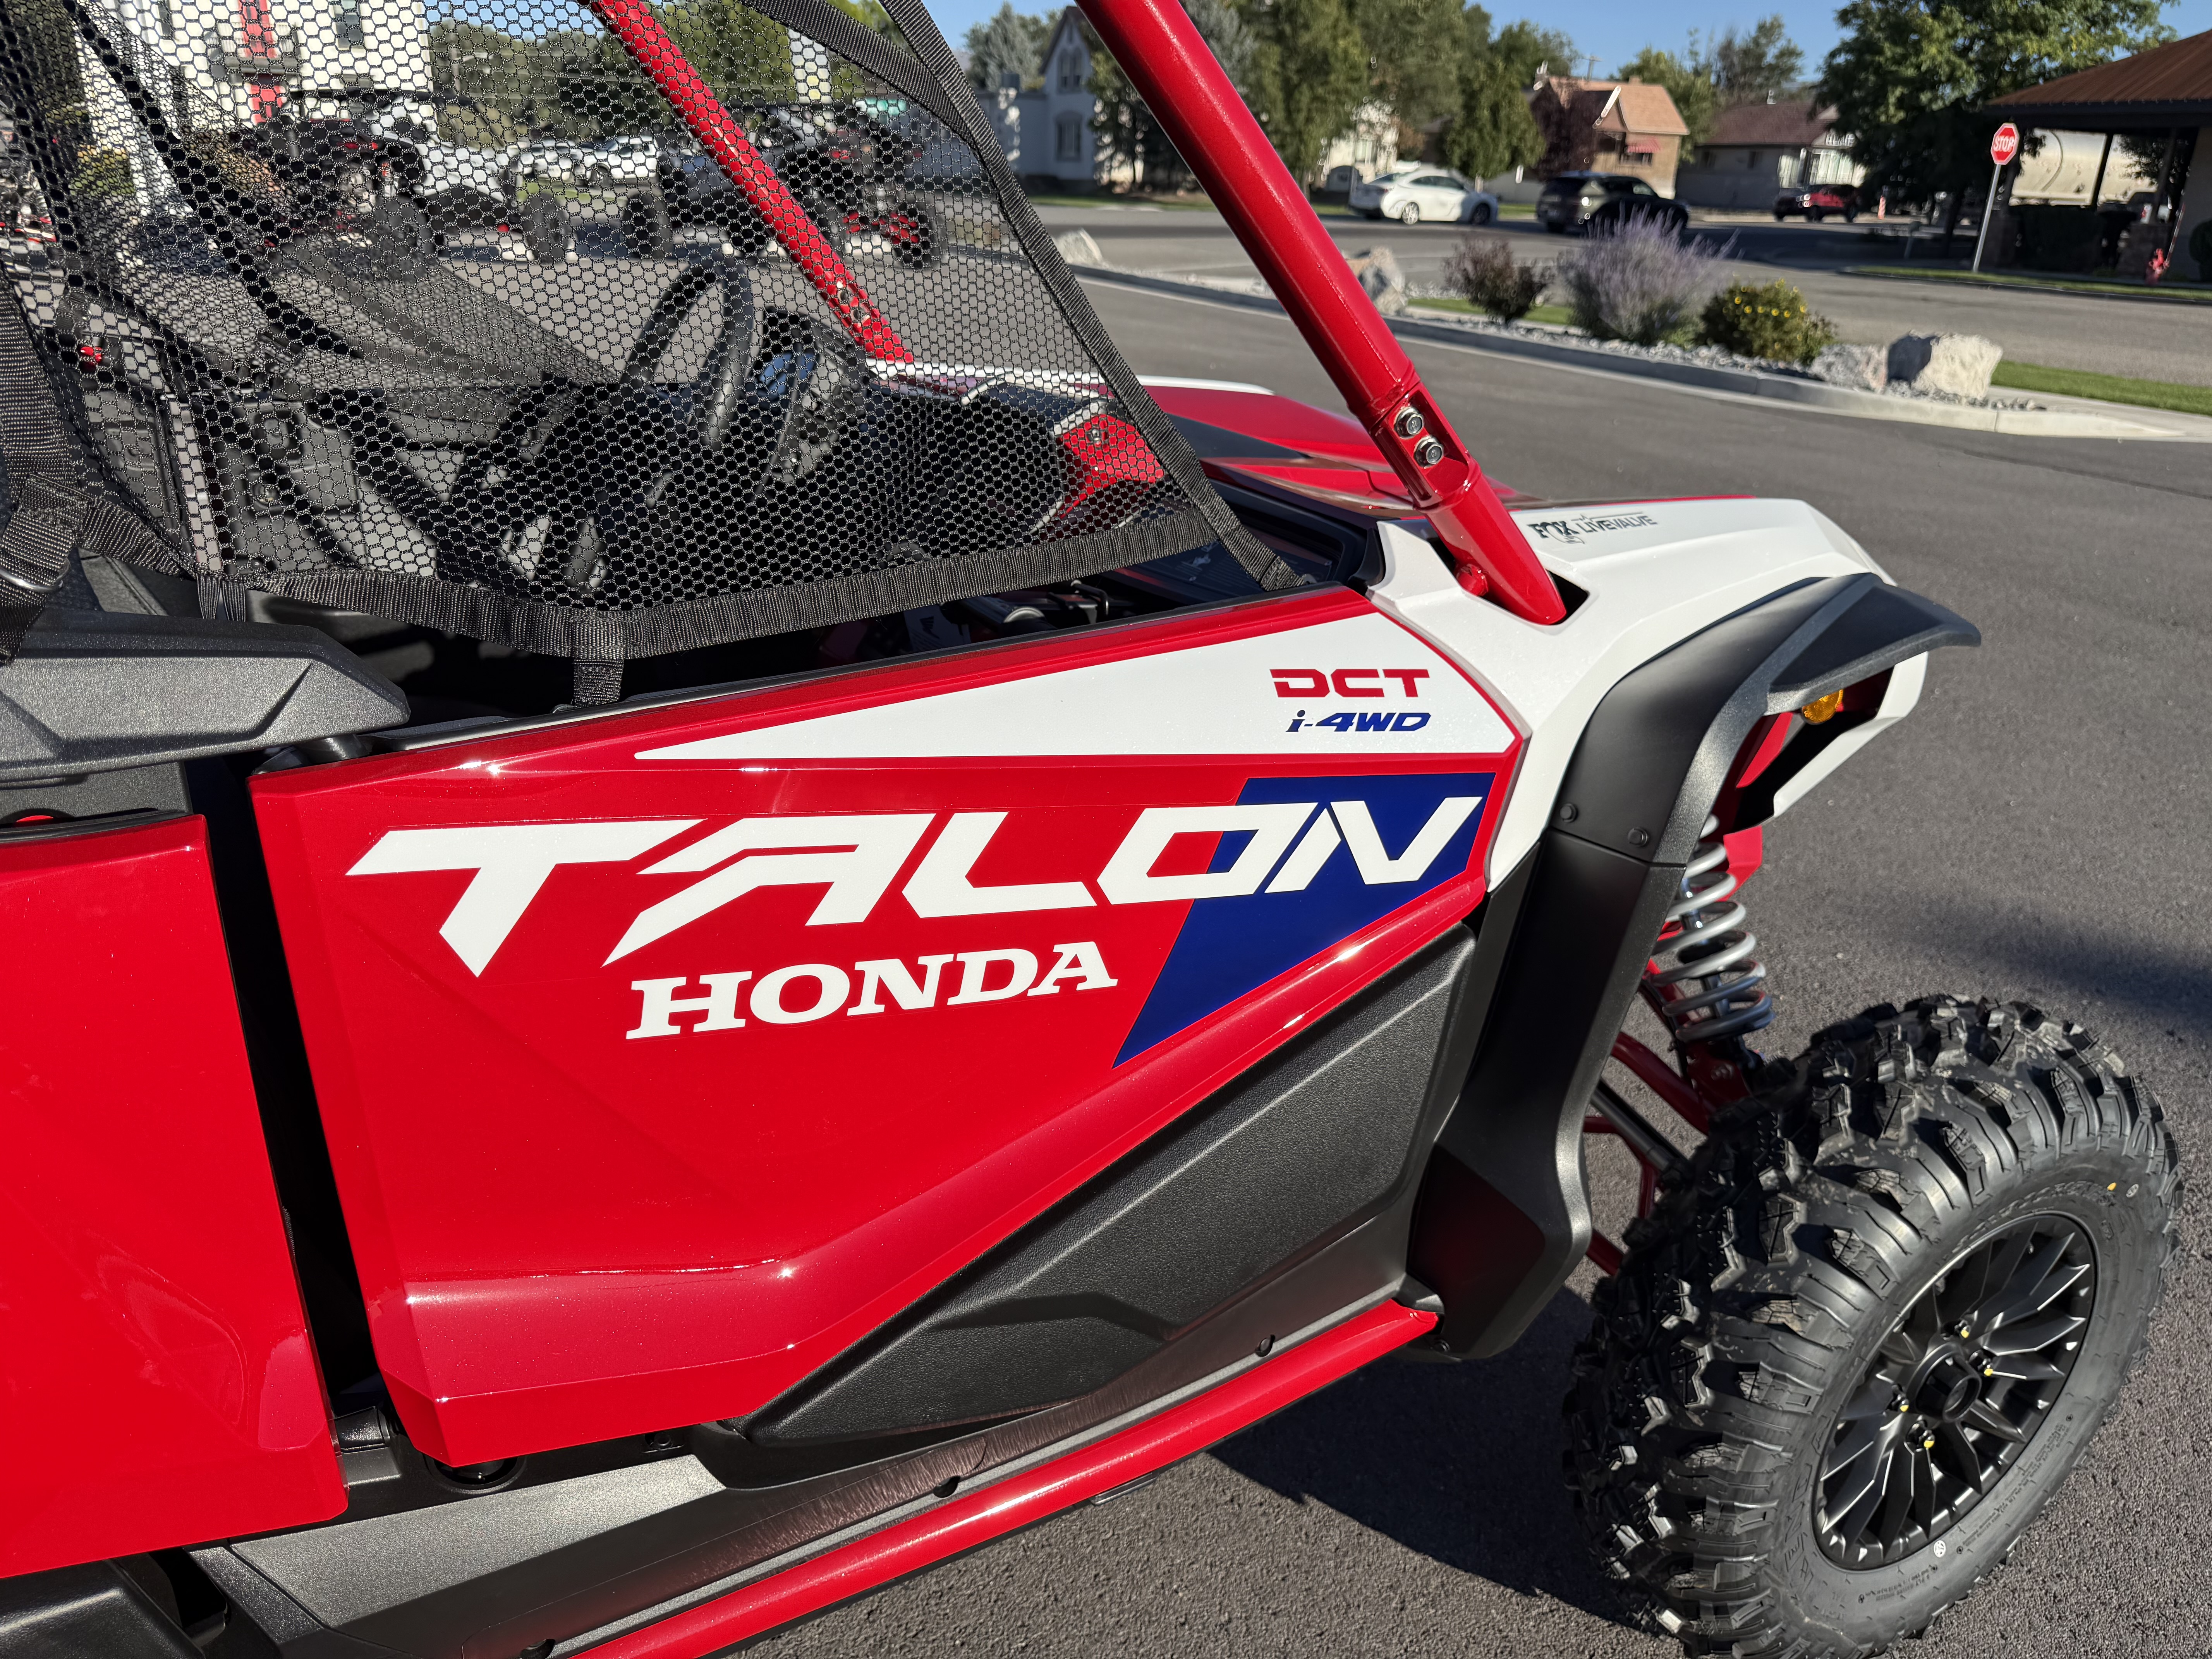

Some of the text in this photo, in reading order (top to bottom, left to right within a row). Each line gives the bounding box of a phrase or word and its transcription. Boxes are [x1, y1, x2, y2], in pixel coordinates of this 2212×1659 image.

[1993, 136, 2015, 152] STOP
[1527, 520, 1584, 544] FOX
[1270, 669, 1430, 697] DCT
[1285, 709, 1431, 732] i-4WD
[345, 797, 1482, 977] TALON
[626, 941, 1118, 1039] HONDA
